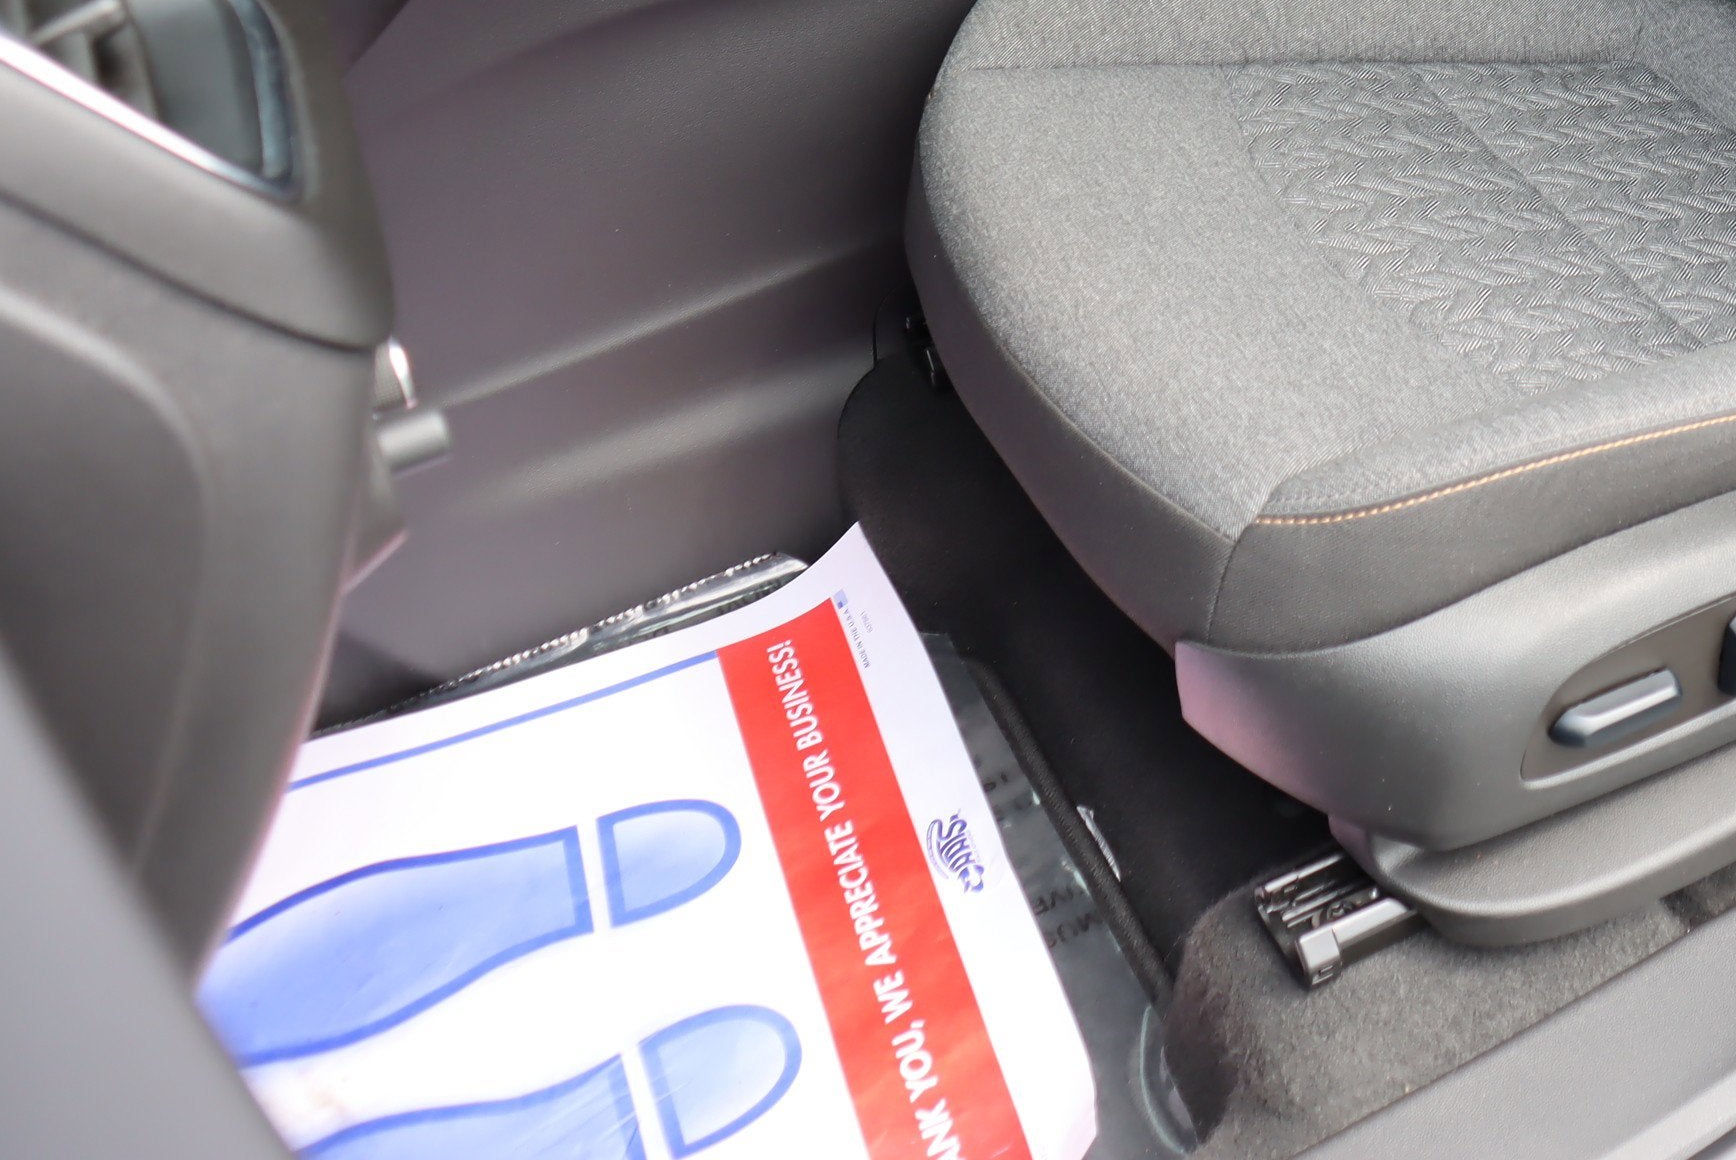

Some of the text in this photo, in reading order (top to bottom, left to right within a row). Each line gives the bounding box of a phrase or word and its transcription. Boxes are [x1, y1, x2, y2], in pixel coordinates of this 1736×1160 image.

[767, 640, 822, 749] BUSINESS!
[859, 649, 870, 669] MADE
[802, 750, 844, 820] YOUR
[825, 821, 896, 966] APPRECIATE
[873, 970, 912, 1023] WE
[891, 1020, 949, 1105] YOU,
